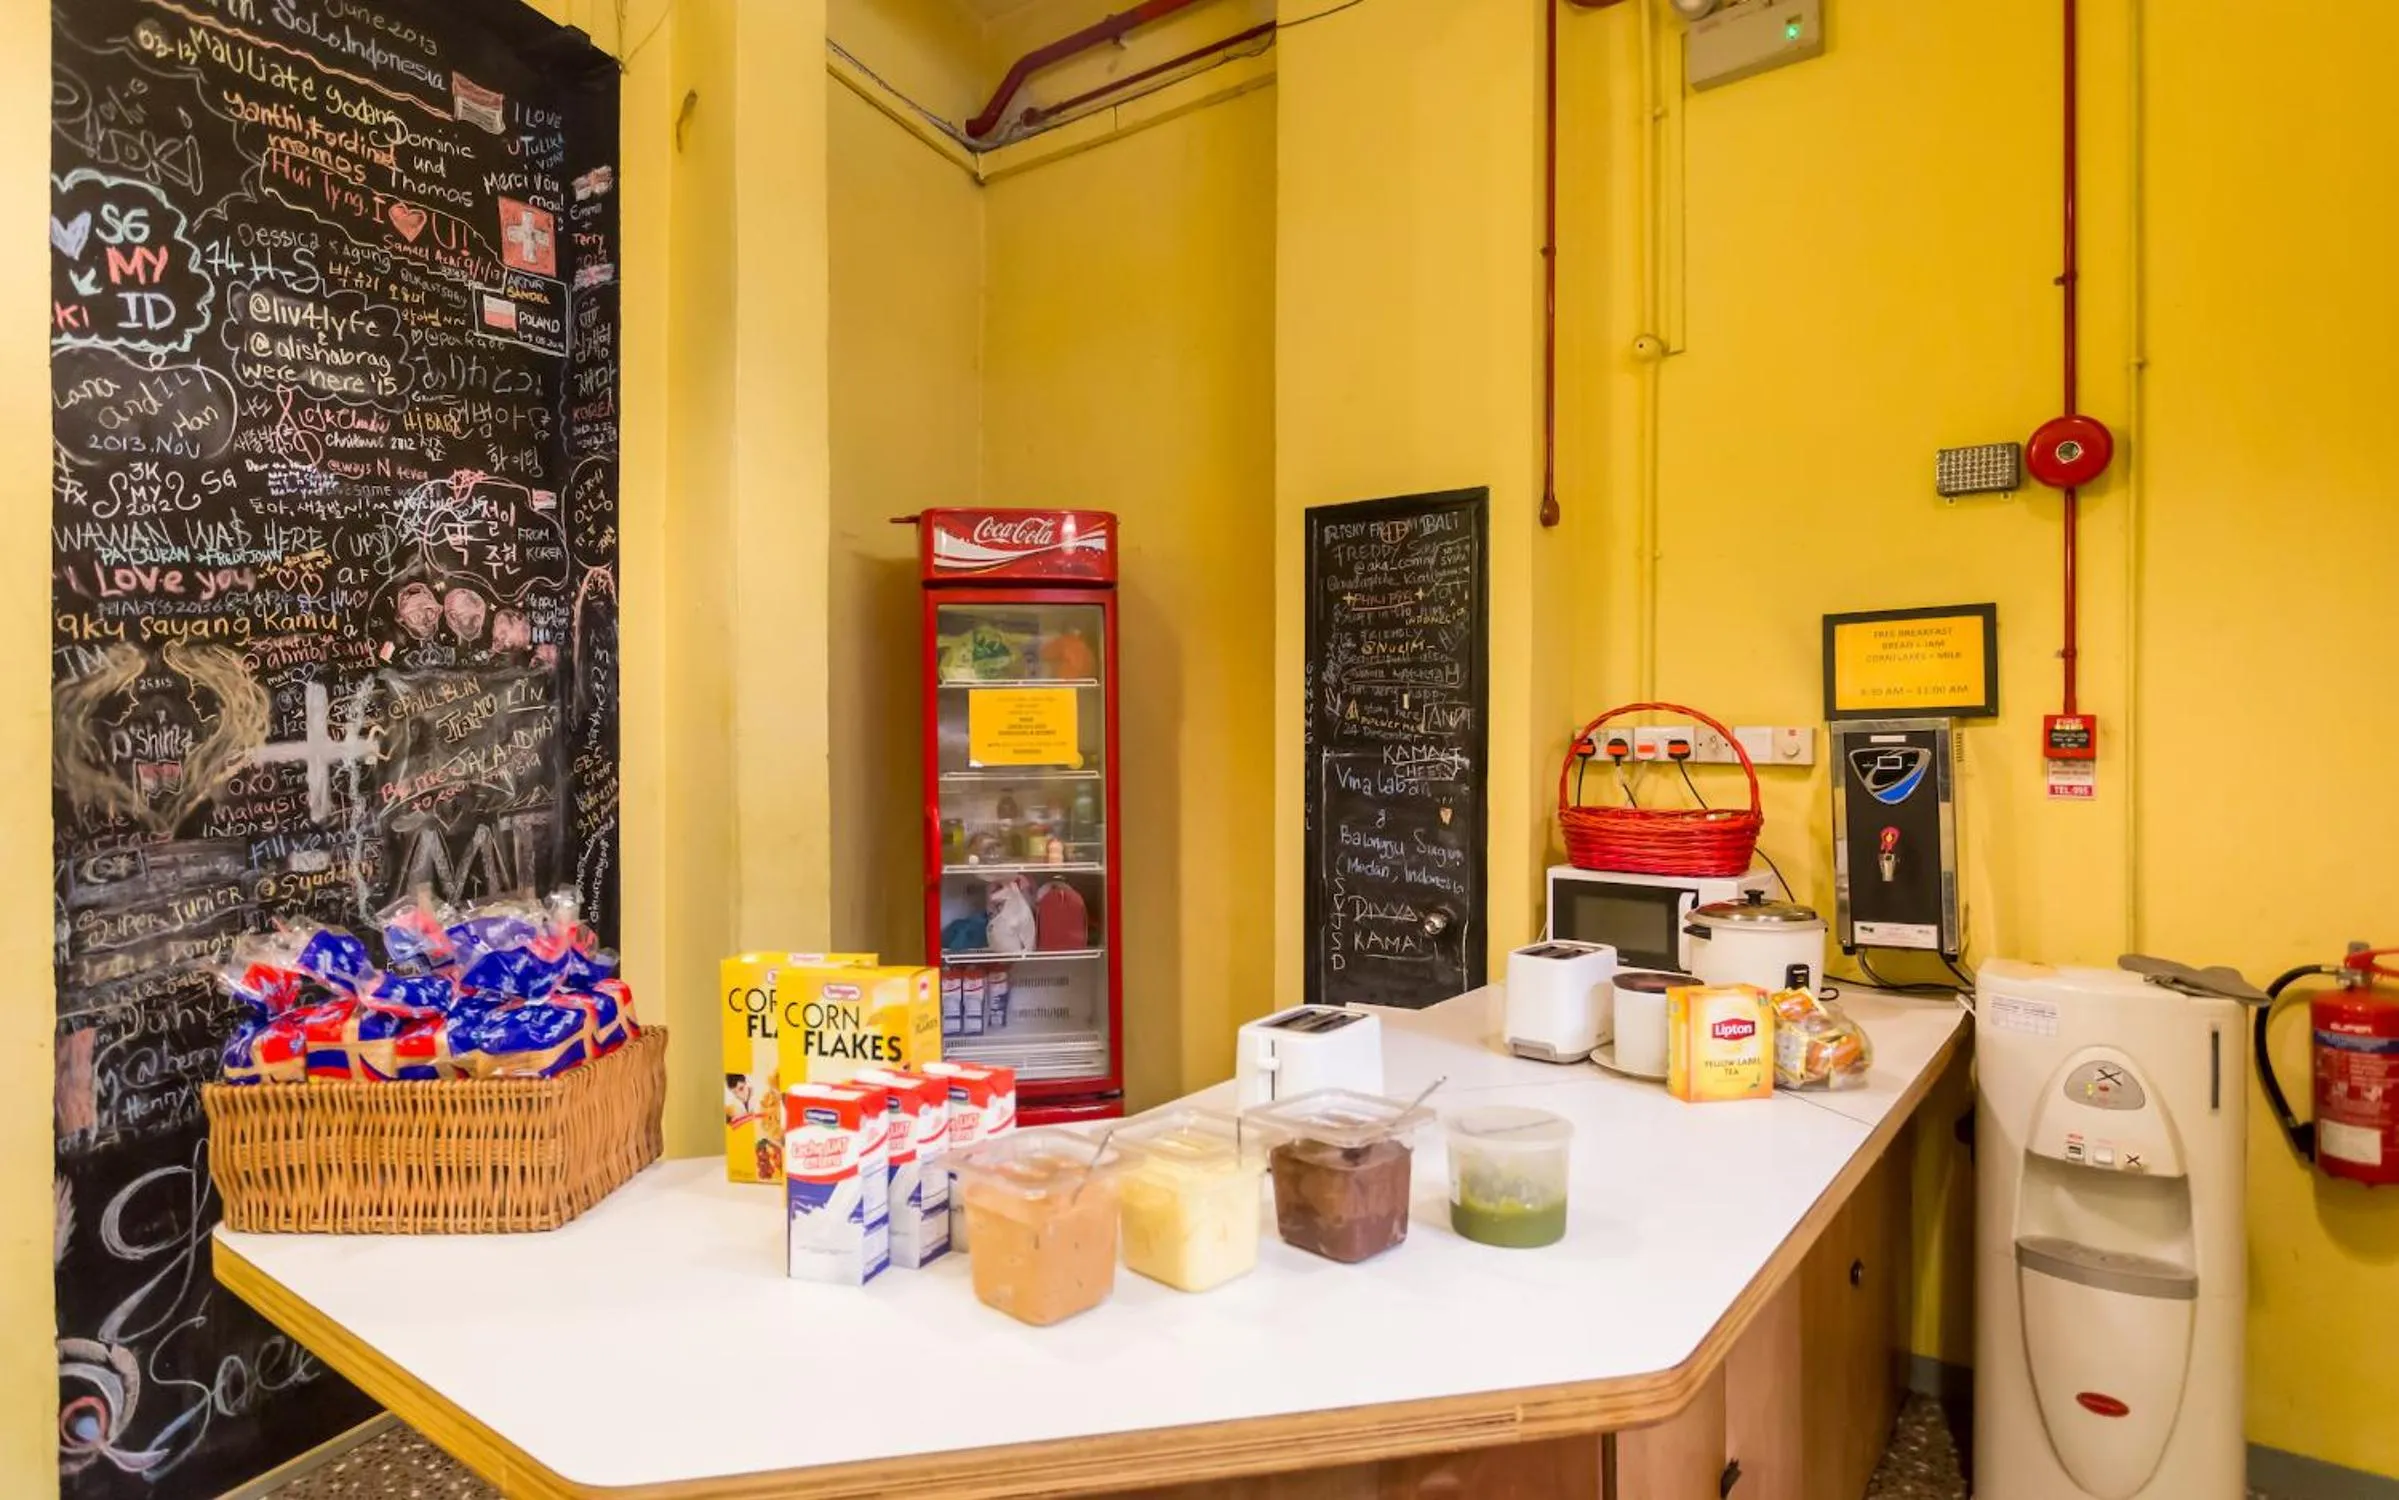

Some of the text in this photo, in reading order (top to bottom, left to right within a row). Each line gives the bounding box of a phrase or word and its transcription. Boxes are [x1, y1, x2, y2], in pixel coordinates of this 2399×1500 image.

[387, 20, 438, 56] 2013
[525, 106, 562, 129] LOVE
[414, 155, 447, 178] und
[96, 203, 151, 245] SG
[106, 245, 169, 286] MY
[115, 291, 177, 330] ID
[518, 311, 561, 332] POLAND
[241, 361, 298, 388] were
[306, 365, 366, 394] here
[130, 485, 162, 504] MY
[200, 467, 238, 495] SG
[264, 517, 329, 554] HERE
[1897, 625, 1954, 639] BREAKFAST
[784, 1002, 860, 1031] CORN
[1715, 1022, 1753, 1038] Lipton
[803, 1030, 904, 1063] FLAKES
